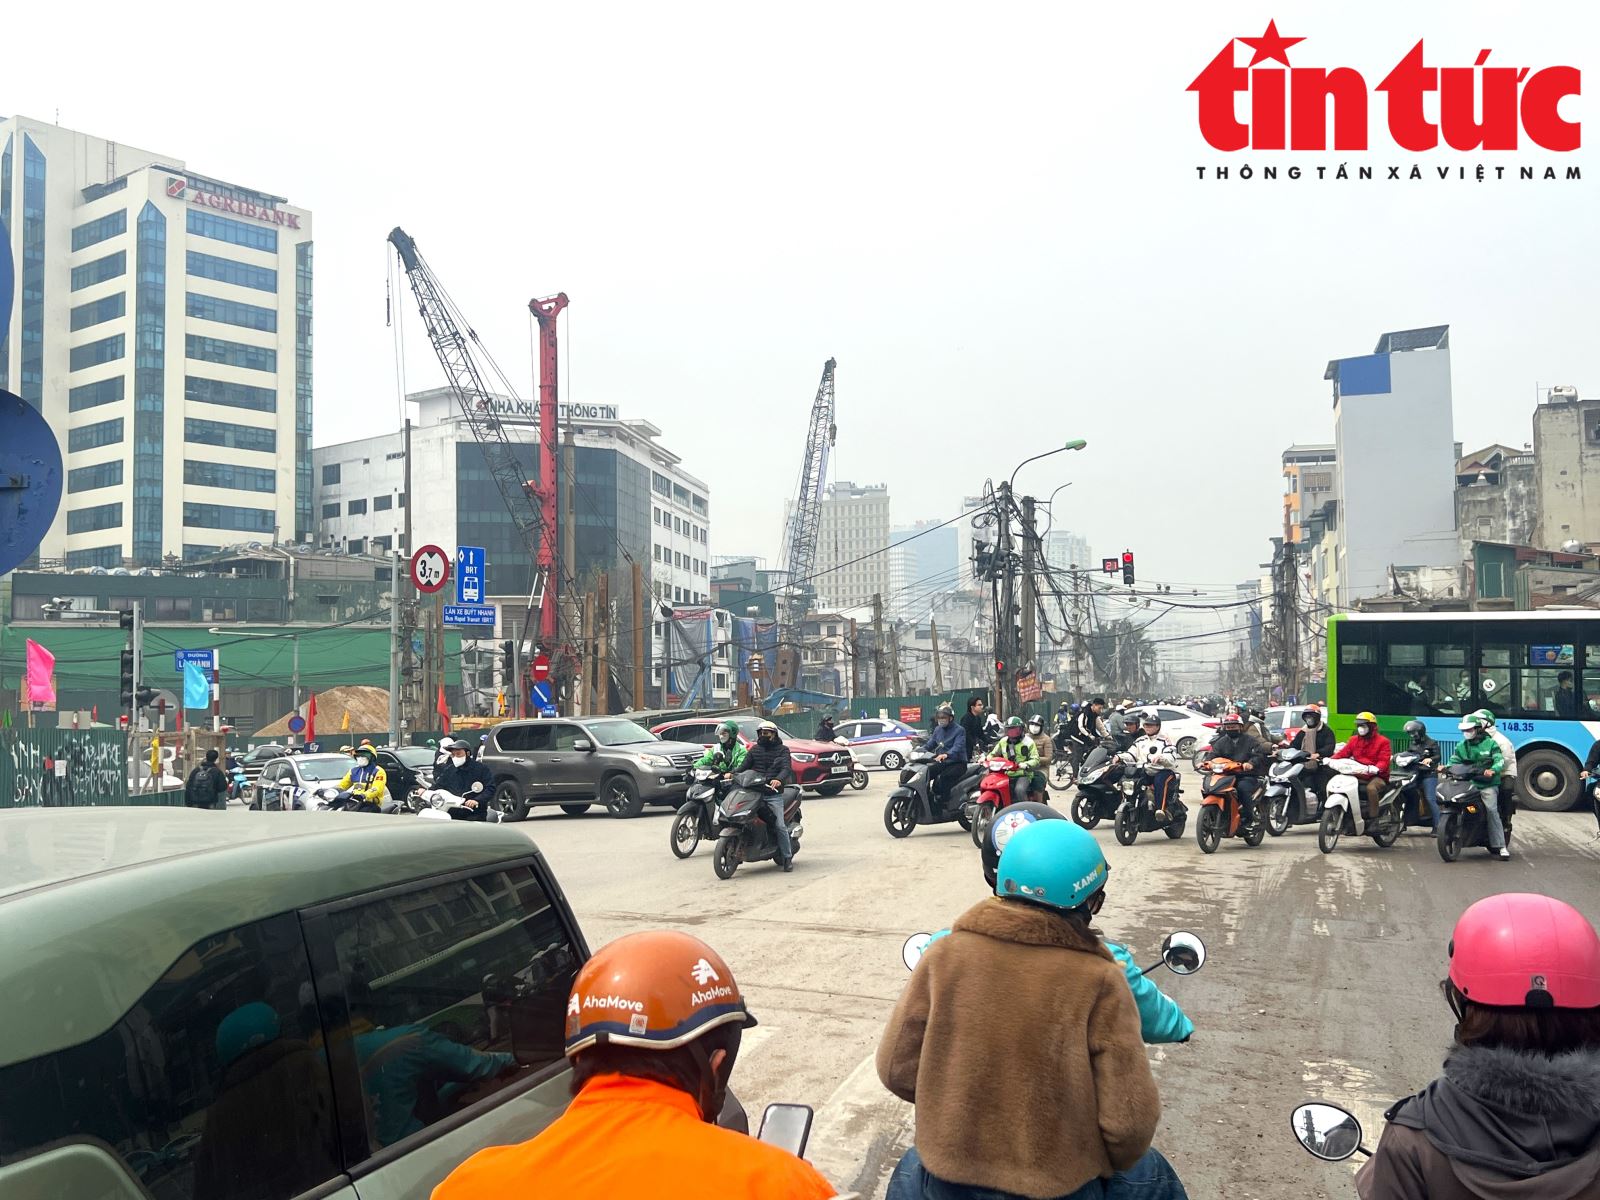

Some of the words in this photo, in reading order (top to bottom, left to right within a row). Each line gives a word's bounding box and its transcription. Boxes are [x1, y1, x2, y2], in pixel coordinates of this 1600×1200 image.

[192, 191, 301, 229] AGRIBANK
[490, 399, 514, 413] NHÀ
[517, 400, 541, 415] KHÁ
[560, 403, 597, 418] THÔNG
[420, 560, 433, 579] 3,7
[465, 566, 478, 574] BRT
[1105, 561, 1117, 571] 21
[1502, 722, 1534, 732] 148.35
[1072, 869, 1098, 892] XANH
[583, 995, 644, 1012] AhaMove
[691, 985, 732, 1007] AhaMove
